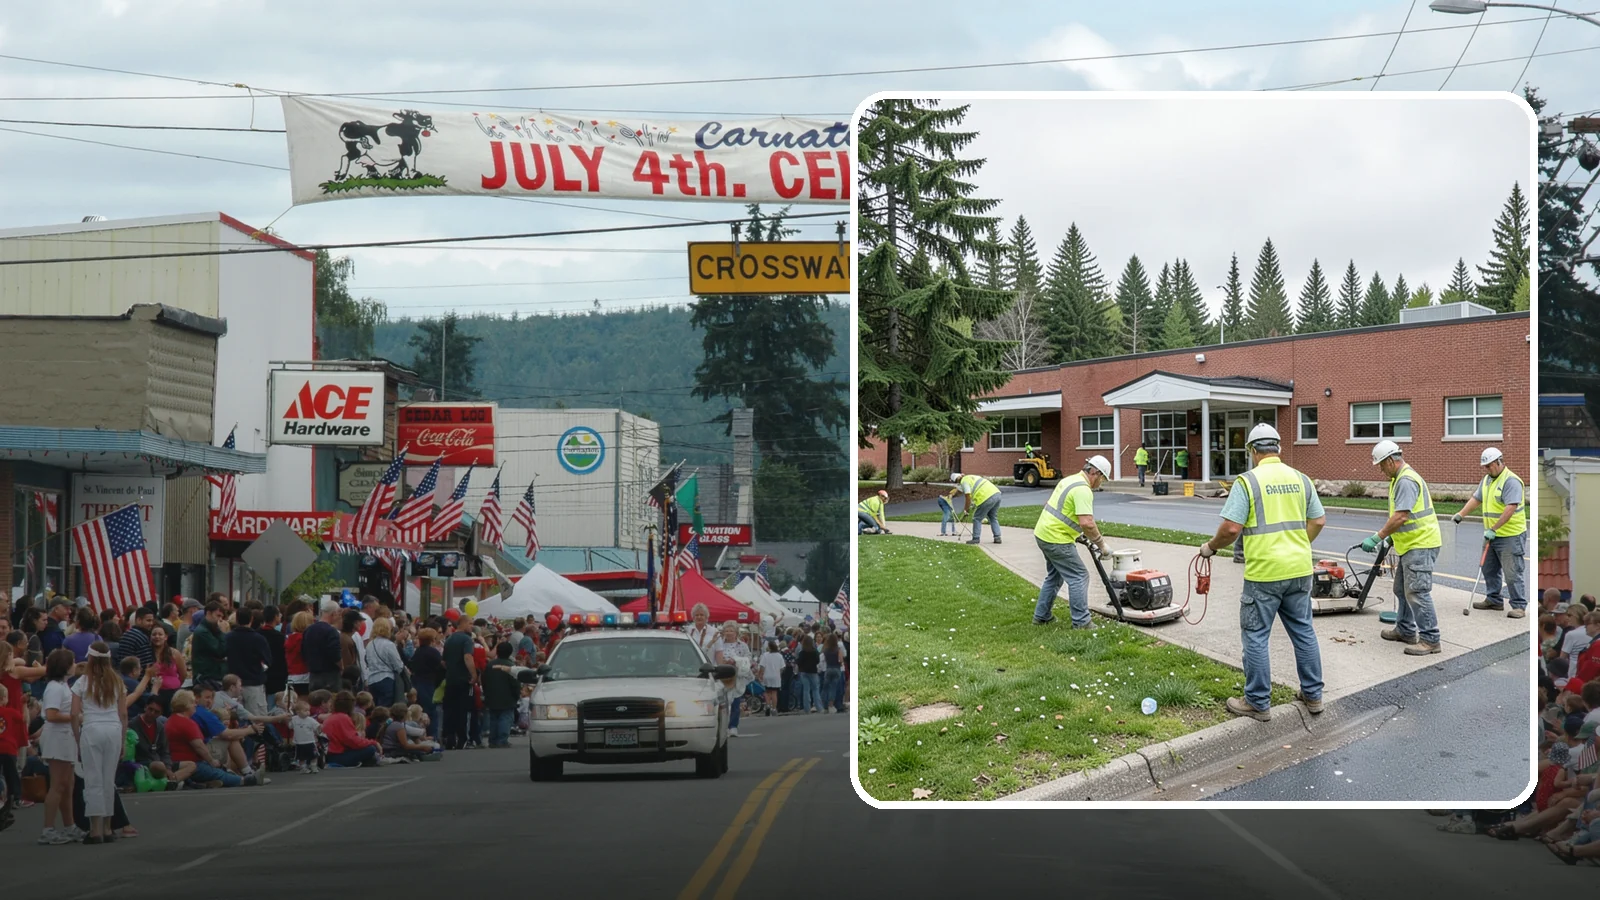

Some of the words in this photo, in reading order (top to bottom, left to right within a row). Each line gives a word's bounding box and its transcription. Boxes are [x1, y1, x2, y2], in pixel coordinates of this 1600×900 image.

[481, 141, 604, 193] JULY
[633, 150, 746, 197] 4th.
[697, 254, 850, 281] CROSSWA
[283, 380, 373, 420] ACE
[405, 409, 453, 422] CEDAR
[461, 409, 485, 422] LOG
[283, 421, 371, 437] Hardware
[416, 428, 477, 447] Coca-Cola
[353, 467, 386, 481] Simpl
[83, 485, 94, 495] St.
[95, 485, 124, 495] Vincent
[126, 486, 136, 495] de
[137, 486, 155, 495] Paul
[688, 526, 742, 535] CRNATION
[699, 535, 730, 543] GLASS
